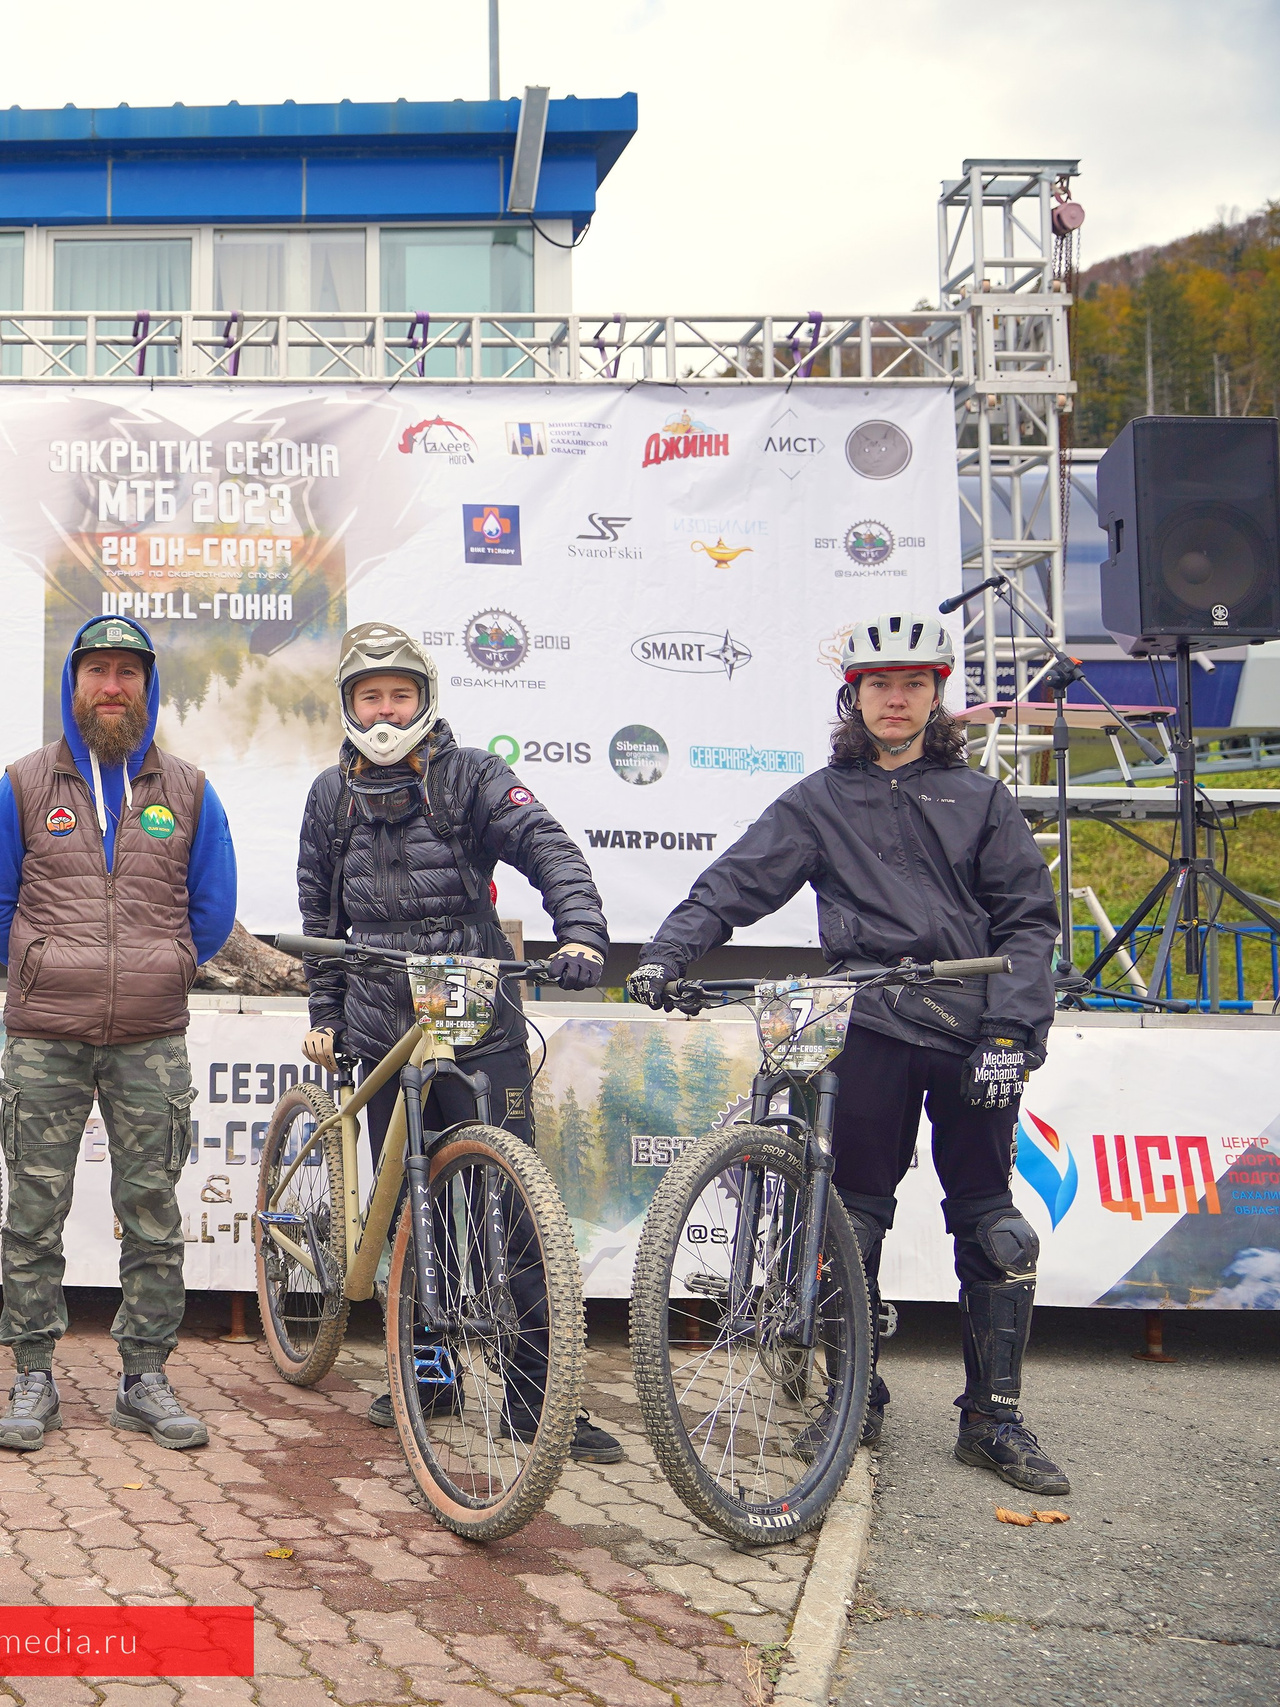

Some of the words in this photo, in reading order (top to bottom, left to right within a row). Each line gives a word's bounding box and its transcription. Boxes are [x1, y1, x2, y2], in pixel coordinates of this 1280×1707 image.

[548, 421, 613, 430] МИНИСТЕРСТВО
[549, 429, 582, 437] СПОРТА
[550, 437, 608, 447] САХАЛИНСКОЙ
[764, 437, 817, 453] ЛИСТ
[49, 440, 213, 474] ЗАКРЫТИЕ
[225, 441, 340, 477] СЕЗОНА
[551, 447, 587, 455] ОБЛАСТИ
[98, 480, 176, 522] МТБ
[191, 481, 292, 524] 2023
[673, 517, 769, 536] ИЗОБИЛИЕ
[814, 538, 841, 550] EST.
[898, 536, 926, 548] 2018
[149, 536, 293, 567] DH-CROSS
[105, 569, 144, 578] ТУРНИР
[148, 570, 164, 578] ПО
[167, 570, 244, 579] СКОРОСТНОМУ
[248, 571, 290, 580] СПУСКУ
[834, 569, 908, 578] @SAKHMTBE
[422, 631, 459, 646] EST.
[534, 635, 570, 650] 2018
[641, 642, 706, 662] SMART
[450, 676, 547, 689] @SAKHMTBE
[523, 741, 592, 764] 2GIS
[616, 741, 660, 752] Siberian
[615, 757, 661, 768] nutrition
[690, 746, 748, 770] СЕВЕРНАЯ
[760, 751, 804, 773] ЗВЕЗДА
[445, 974, 467, 1017] 3
[446, 1020, 475, 1028] DH-CROSS
[789, 998, 813, 1042] 7
[762, 1144, 785, 1157] BOSS
[1221, 1136, 1269, 1149] ЦЕНТР
[1092, 1134, 1221, 1220] ЦСП
[201, 1174, 232, 1204] &
[417, 1185, 438, 1294] MANITOU
[391, 1353, 406, 1417] SMART
[402, 1424, 417, 1458] SAM
[747, 1514, 794, 1528] WTB
